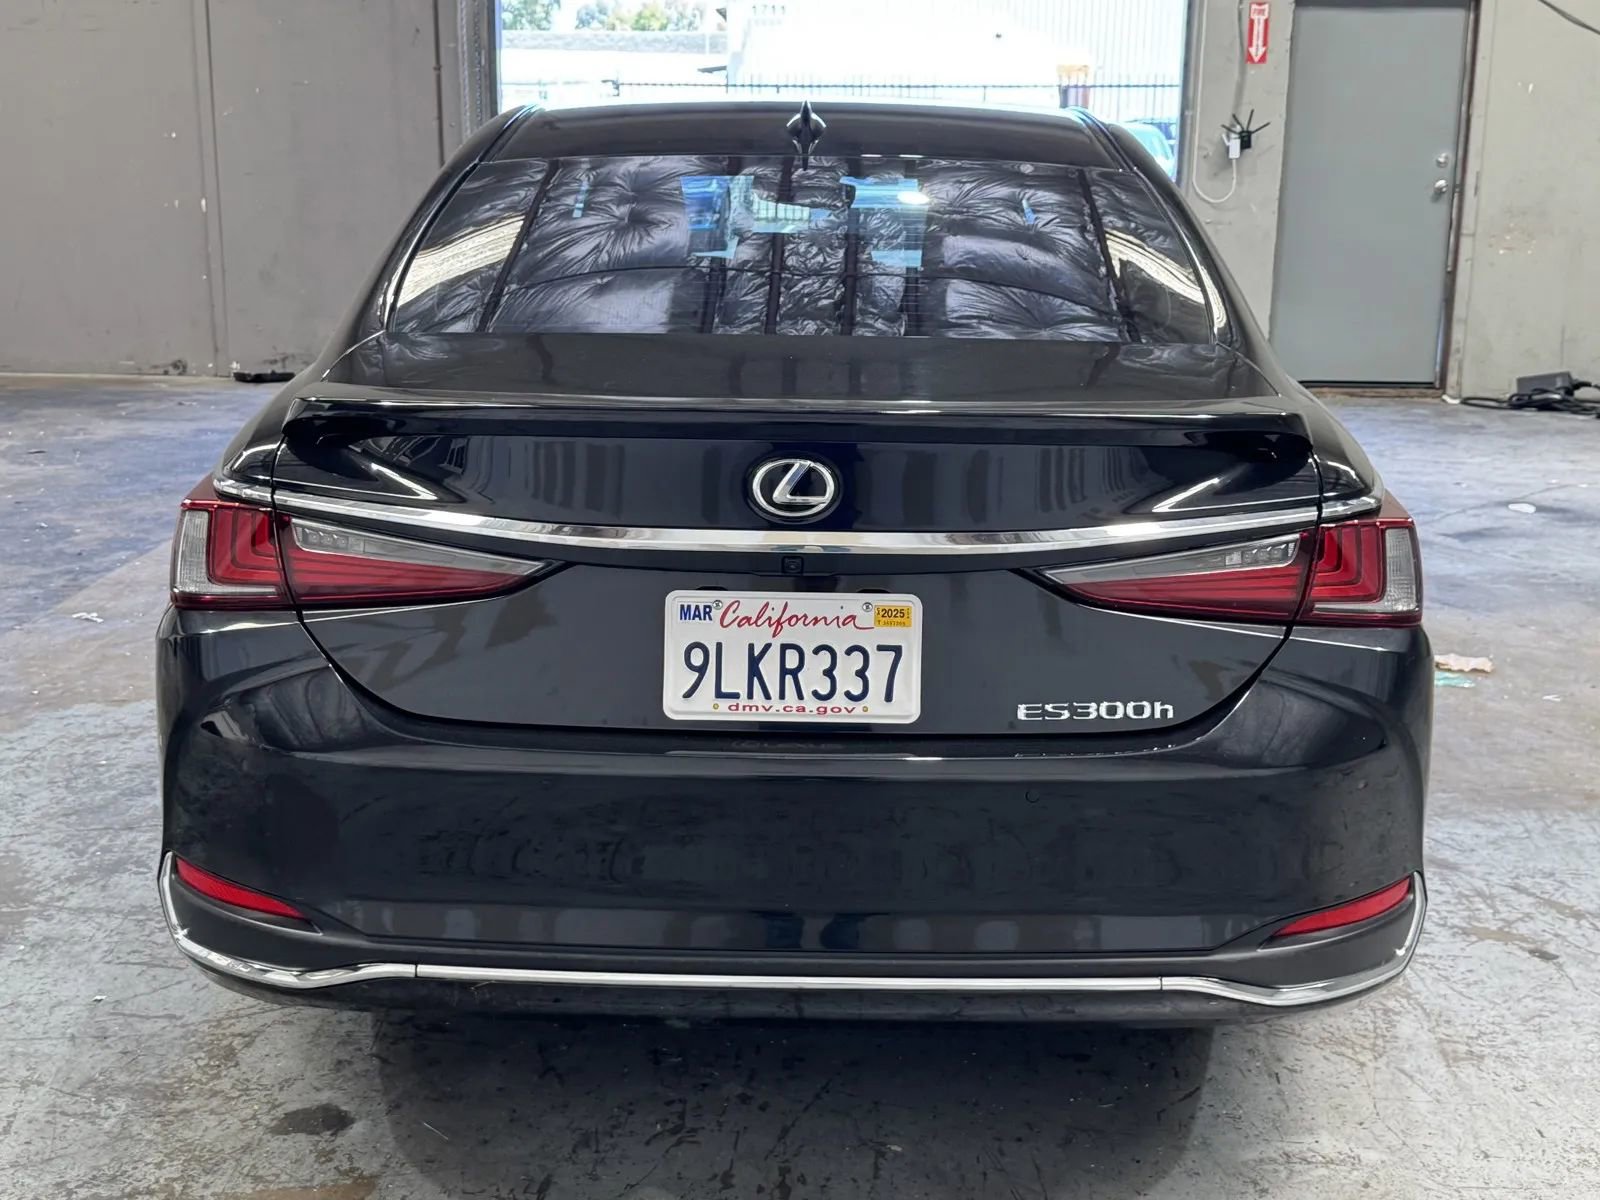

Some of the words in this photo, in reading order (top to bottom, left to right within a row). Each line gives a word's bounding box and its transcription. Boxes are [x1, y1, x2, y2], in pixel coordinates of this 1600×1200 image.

[679, 604, 713, 621] MAR
[719, 599, 875, 638] California
[881, 608, 905, 618] 2025
[682, 641, 903, 703] 9LKR337
[727, 702, 857, 715] dmv.ca.gov
[1017, 700, 1174, 721] ES300h
